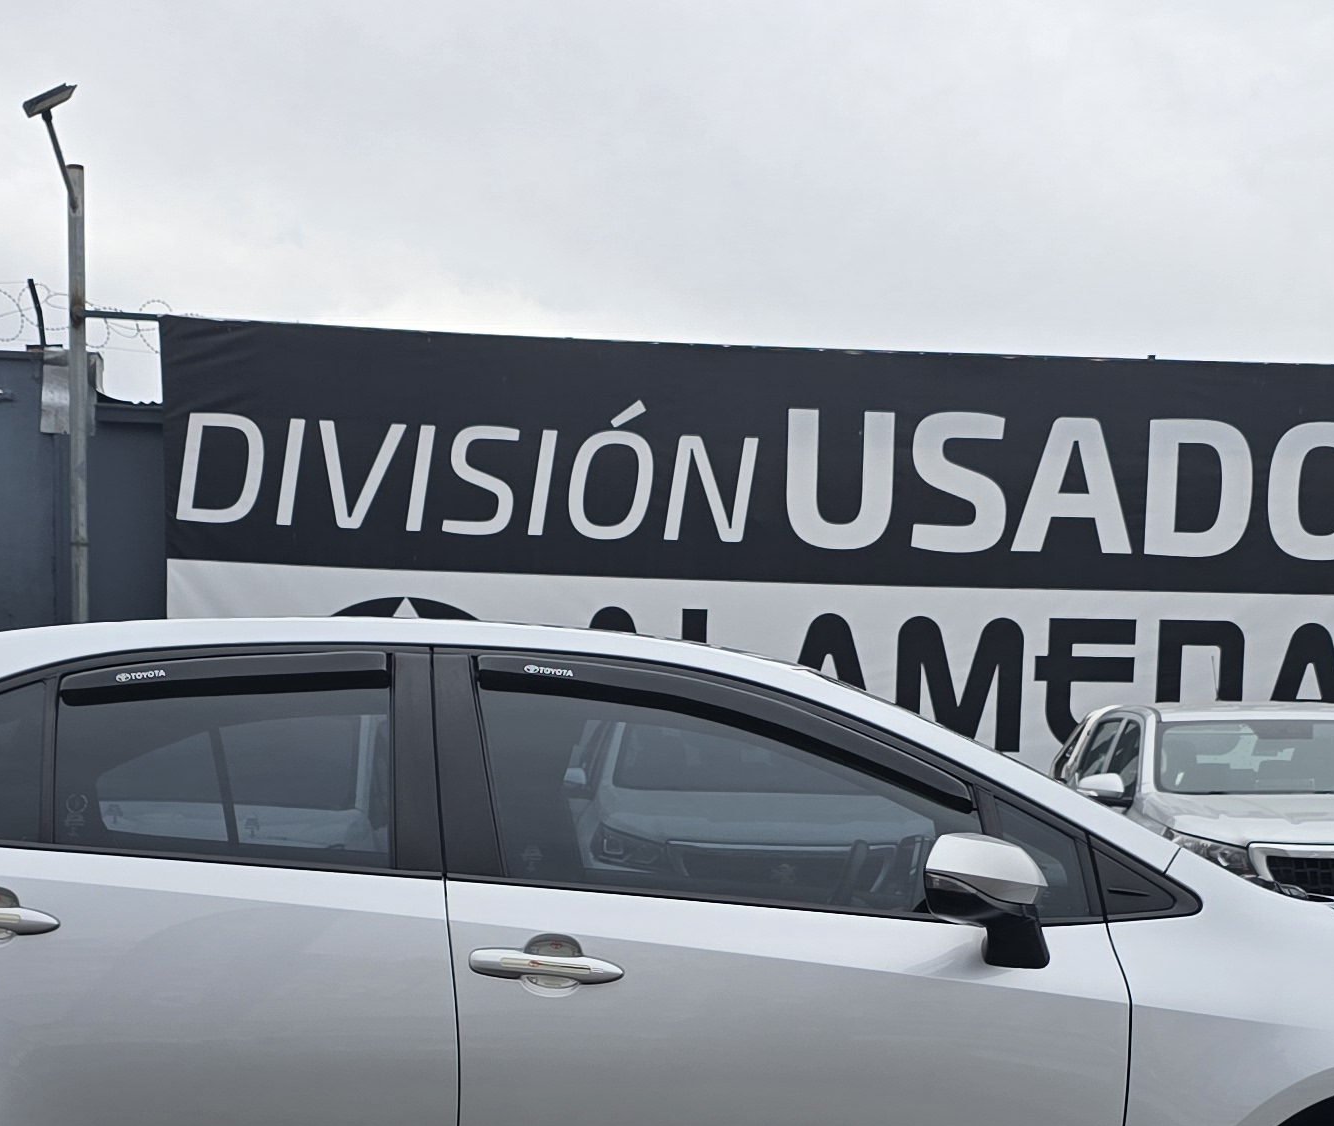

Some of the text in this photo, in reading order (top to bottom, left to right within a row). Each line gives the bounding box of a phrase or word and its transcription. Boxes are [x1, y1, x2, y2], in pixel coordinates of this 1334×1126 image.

[176, 400, 759, 542] DIVISIÓN
[131, 670, 165, 679] TOYOTA
[539, 667, 573, 677] TOYOTA
